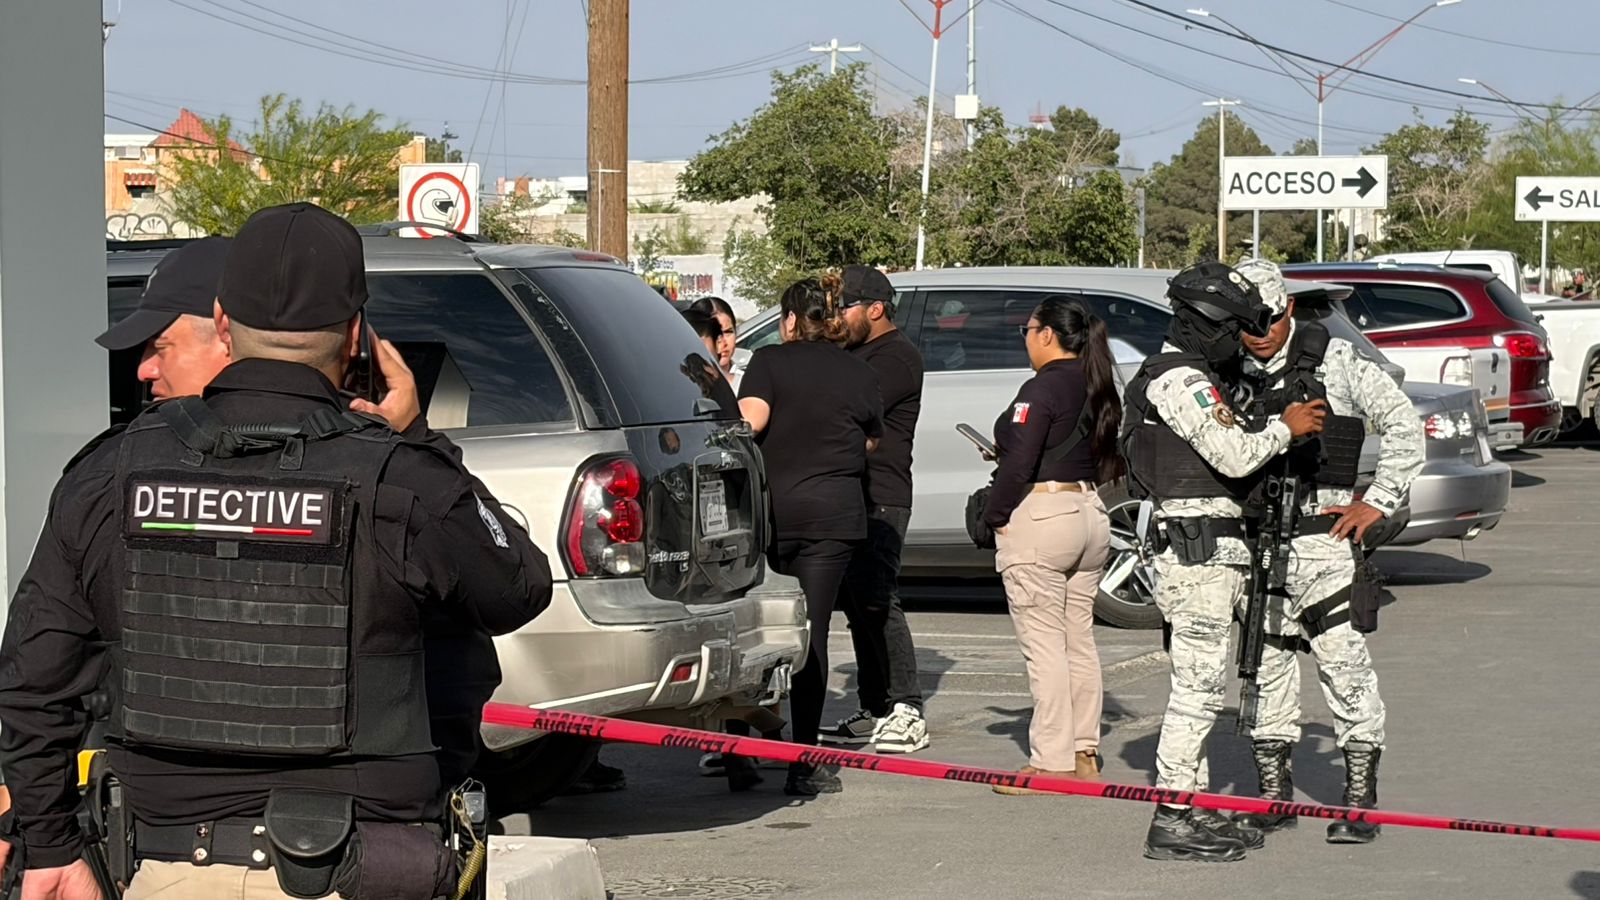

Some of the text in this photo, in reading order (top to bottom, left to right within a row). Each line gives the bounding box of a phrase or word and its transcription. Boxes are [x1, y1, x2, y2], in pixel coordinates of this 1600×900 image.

[1228, 170, 1336, 195] ACCESO
[1558, 188, 1600, 209] SAL
[133, 485, 324, 526] DETECTIVE
